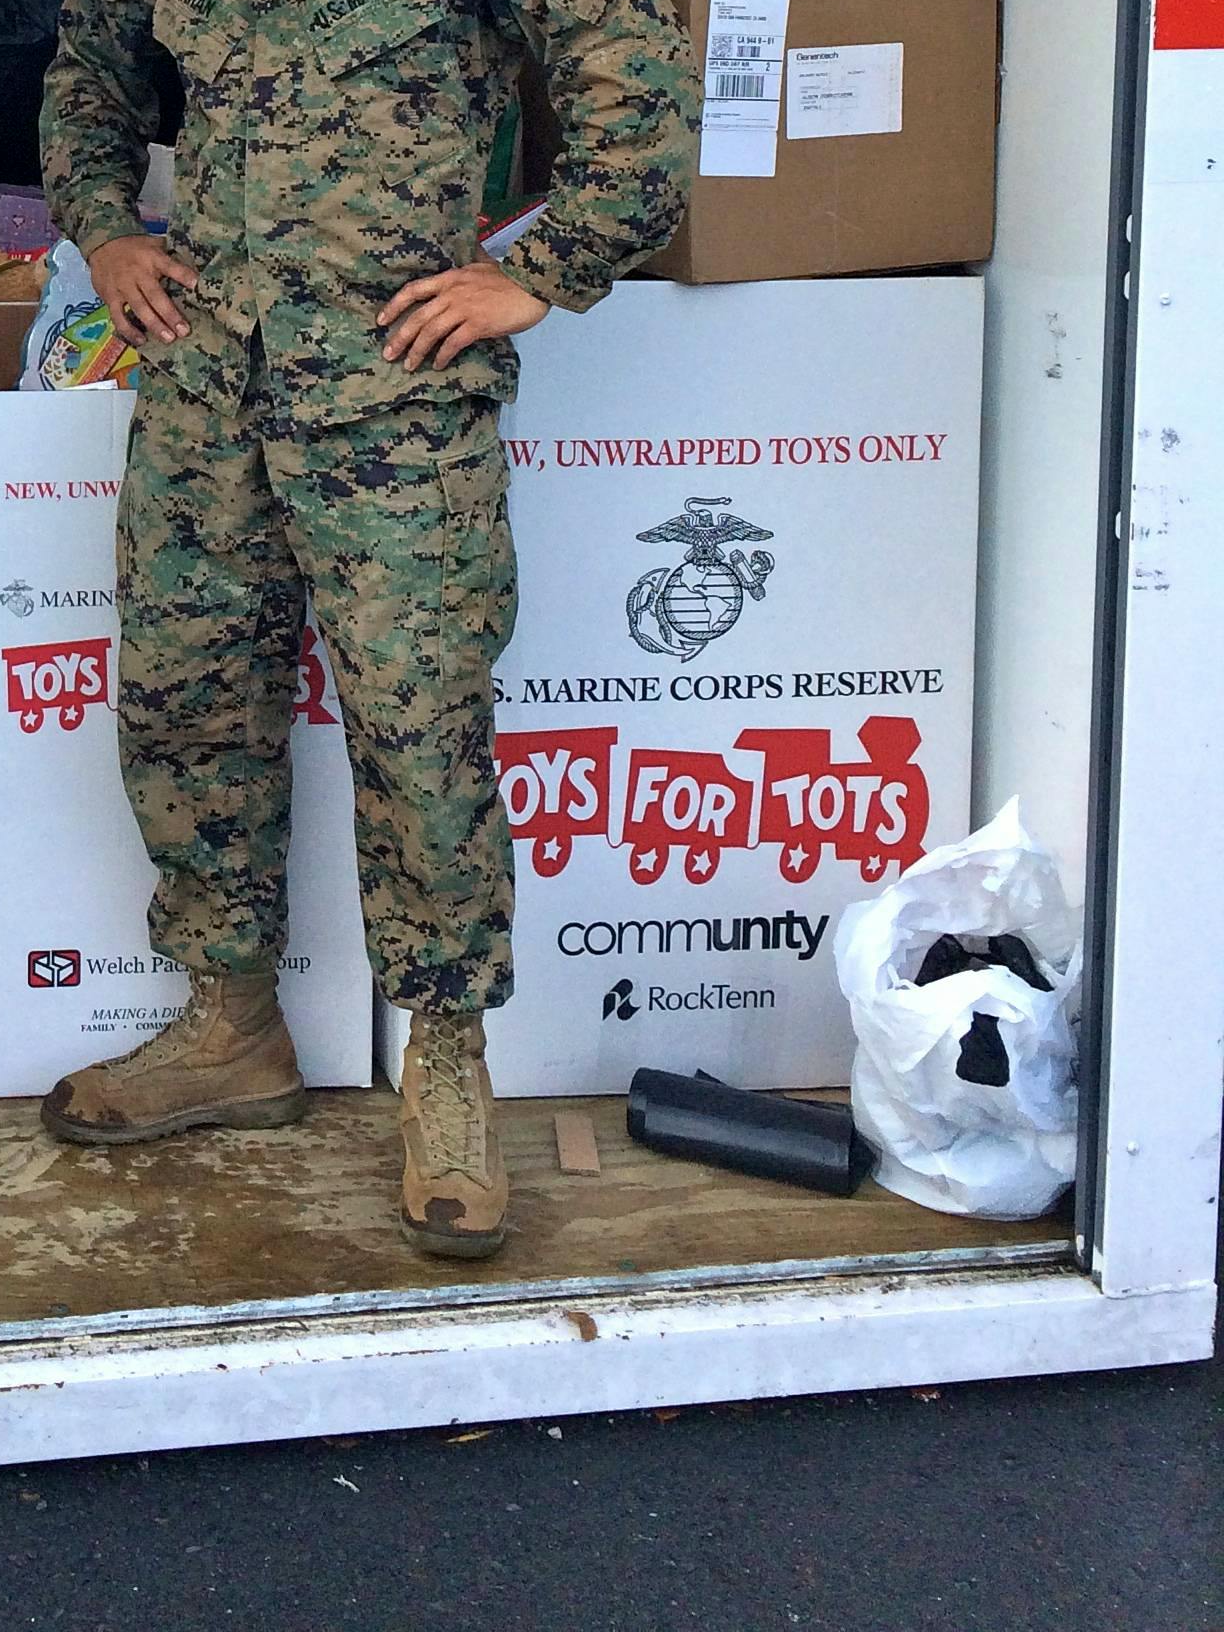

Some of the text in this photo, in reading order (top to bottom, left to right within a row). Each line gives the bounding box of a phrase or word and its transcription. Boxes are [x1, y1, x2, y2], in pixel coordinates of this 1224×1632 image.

[556, 439, 761, 467] UNWRAPPED
[769, 436, 852, 465] TOYS
[859, 434, 948, 462] ONLY
[5, 481, 62, 502] NEW,
[39, 589, 117, 608] MARIN
[11, 652, 101, 701] TOYS
[520, 676, 662, 704] MARINE
[669, 674, 784, 703] CORPS
[791, 669, 945, 699] RESERVE
[493, 748, 908, 845] OYS FOR TOTS
[558, 909, 830, 961] community
[87, 956, 145, 975] Welch
[277, 956, 312, 974] oup
[649, 984, 776, 1012] RockTenn
[81, 1023, 117, 1033] FAMILY
[92, 1007, 147, 1021] MAKING
[149, 1007, 161, 1020] A
